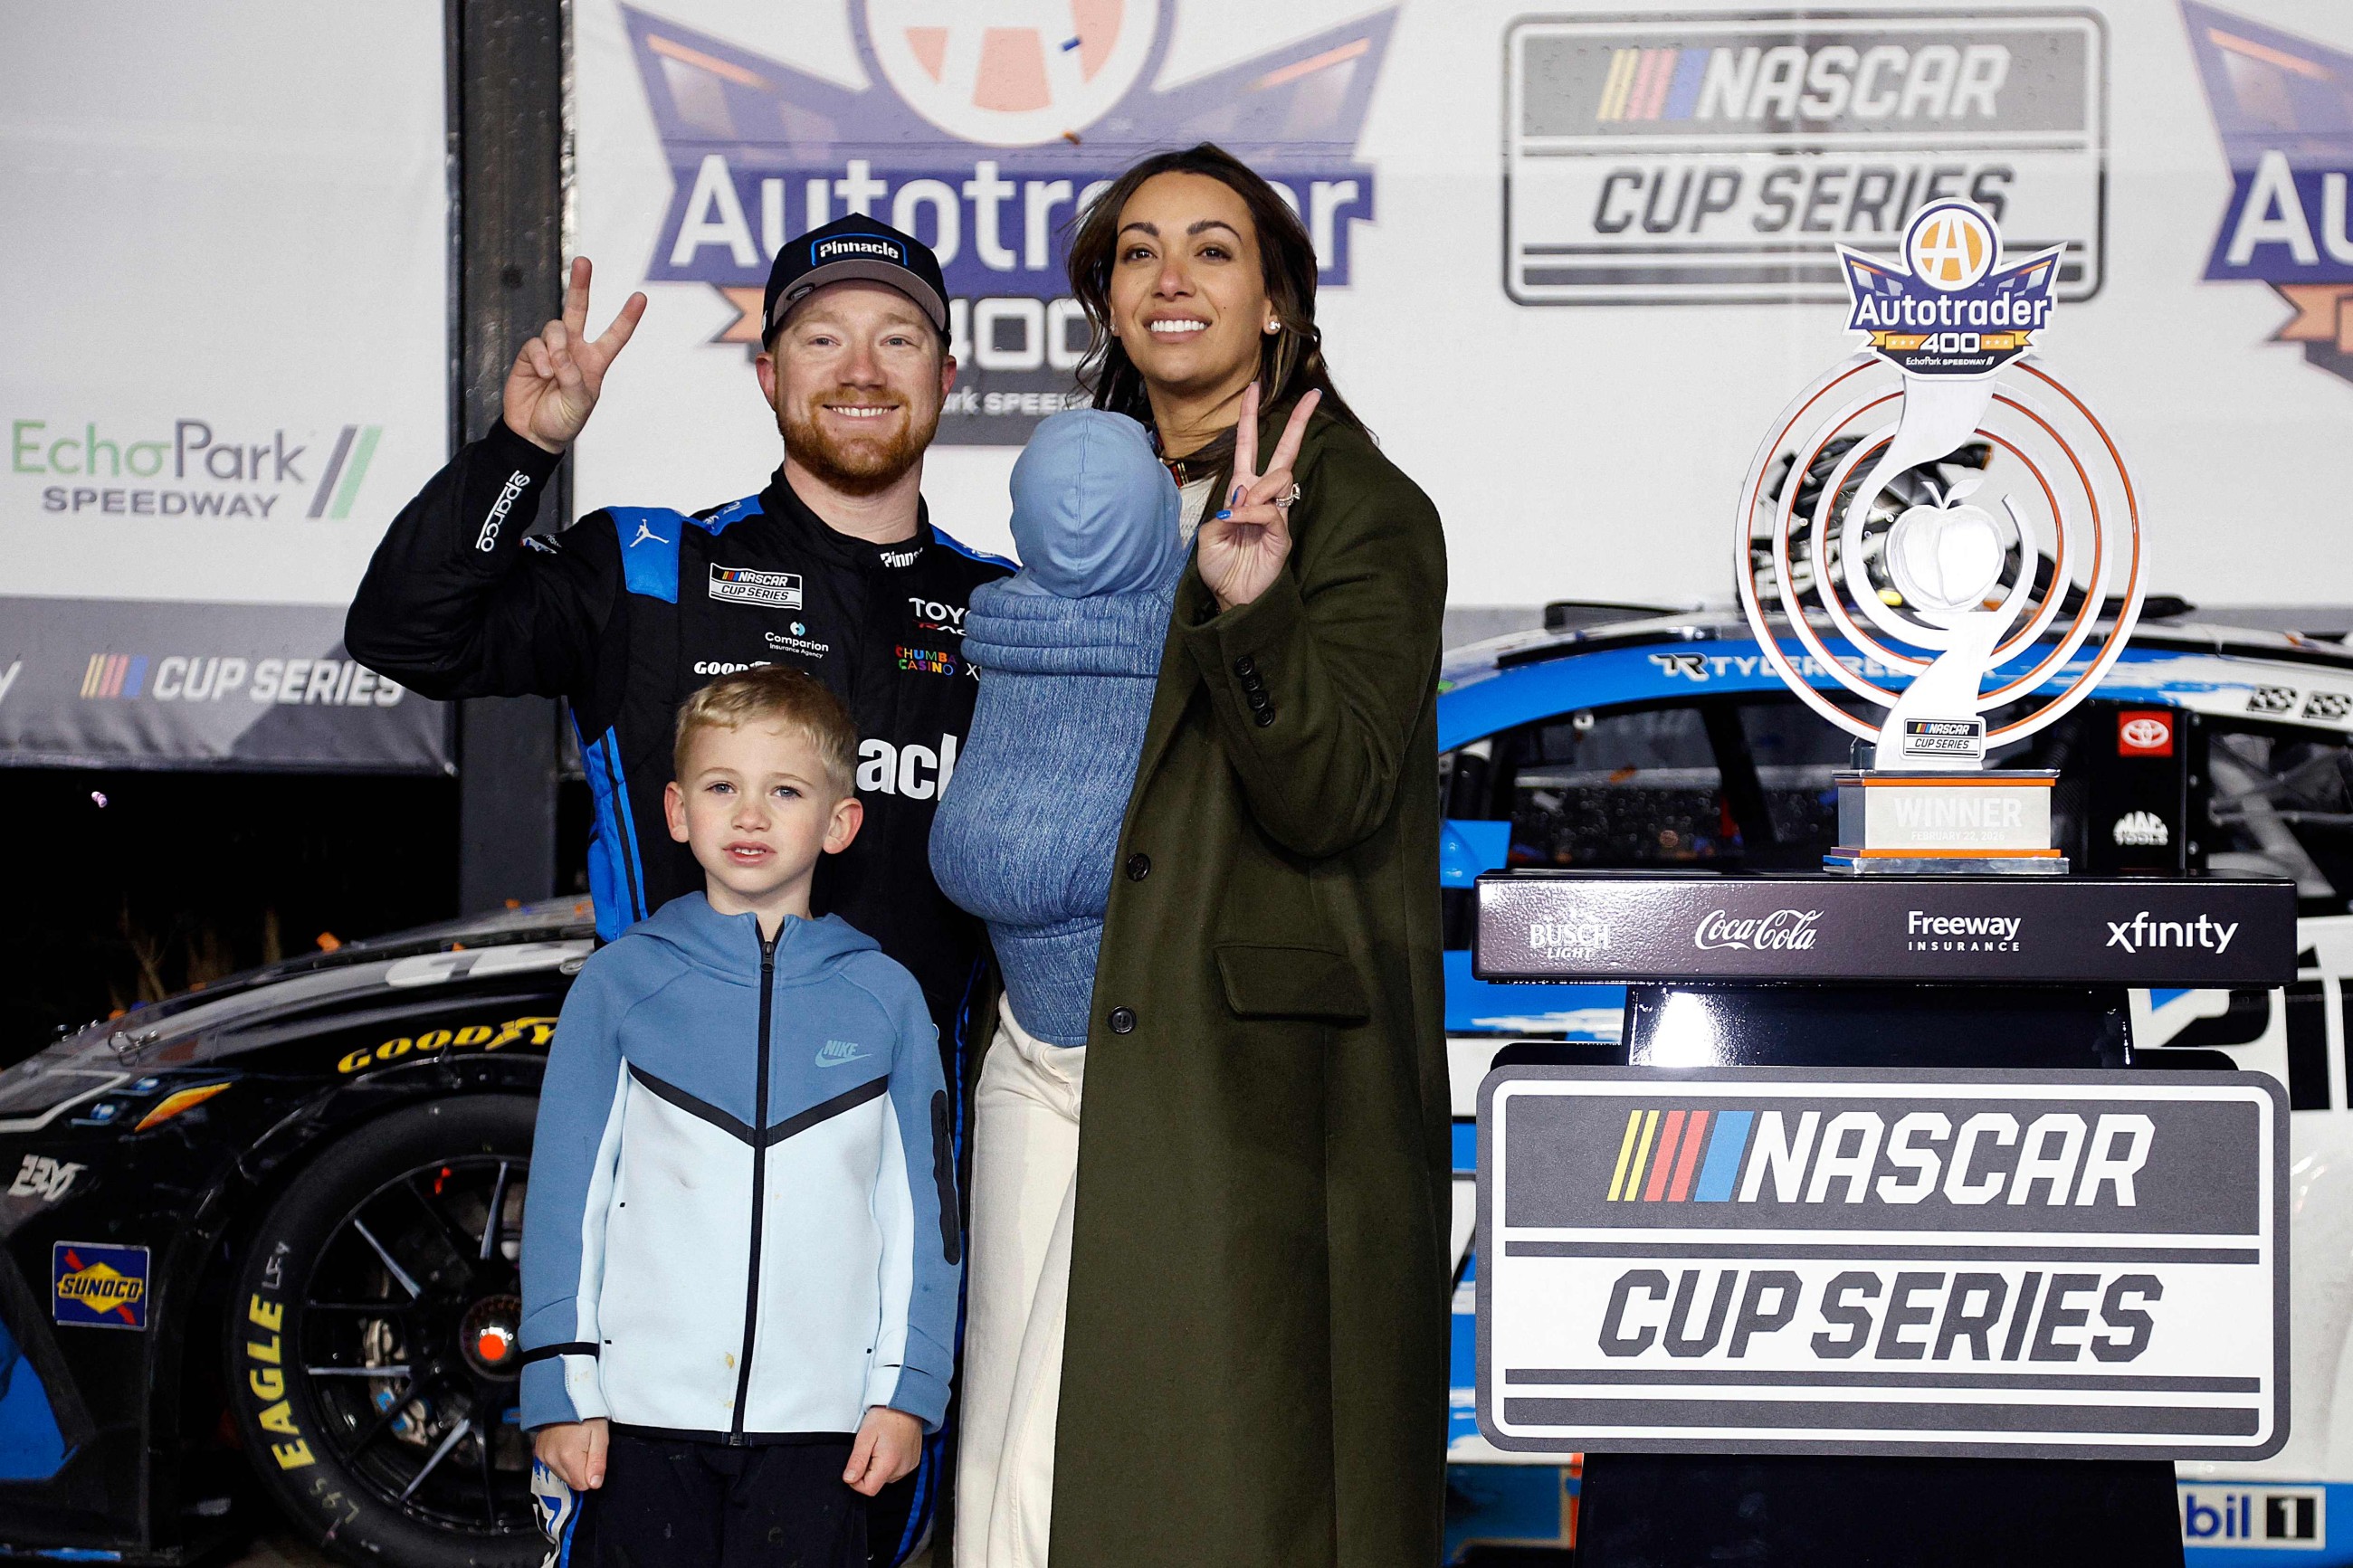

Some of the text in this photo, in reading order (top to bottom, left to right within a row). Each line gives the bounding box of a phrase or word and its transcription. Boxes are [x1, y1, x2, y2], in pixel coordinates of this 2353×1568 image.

[1696, 45, 2012, 119] NASCAR
[669, 153, 1359, 271] Autotrr
[1594, 165, 1744, 234] CUP
[820, 241, 899, 260] Pinnacle
[1855, 291, 2048, 327] Autotrader
[1920, 332, 1981, 354] 400
[1906, 356, 1942, 366] EchoPark
[12, 418, 308, 485] EchoPark
[42, 486, 281, 519] SPEEDWAY
[475, 470, 530, 552] sparco
[738, 572, 788, 586] NASCAR
[721, 584, 790, 601] CUP SERIES
[909, 597, 972, 624] TOY
[765, 632, 830, 652] Comparion
[769, 642, 824, 659] Insurance Agency
[895, 644, 957, 665] CHUMBA
[899, 659, 955, 676] CASINO
[152, 656, 407, 708] CUP SERIES
[1929, 724, 1970, 735] NASCAR
[1915, 738, 1969, 749] CUP SERIES
[1893, 797, 2023, 828] WINNER
[1911, 831, 1961, 841] FEBRUARY
[1529, 923, 1610, 948] BUSCH
[1908, 910, 2022, 941] Freeway
[2105, 911, 2240, 955] xfinity
[1547, 946, 1594, 959] LIGHT
[1908, 941, 2020, 952] INSURANCE
[337, 1016, 559, 1074] GOODY
[824, 1040, 859, 1058] NIKE
[1739, 1110, 2156, 1207] NASCAR
[62, 1278, 140, 1299] SUNOCO
[1597, 1269, 2165, 1364] CUP SERIES
[247, 1292, 316, 1471] EAGLE
[2186, 1494, 2253, 1539] bil
